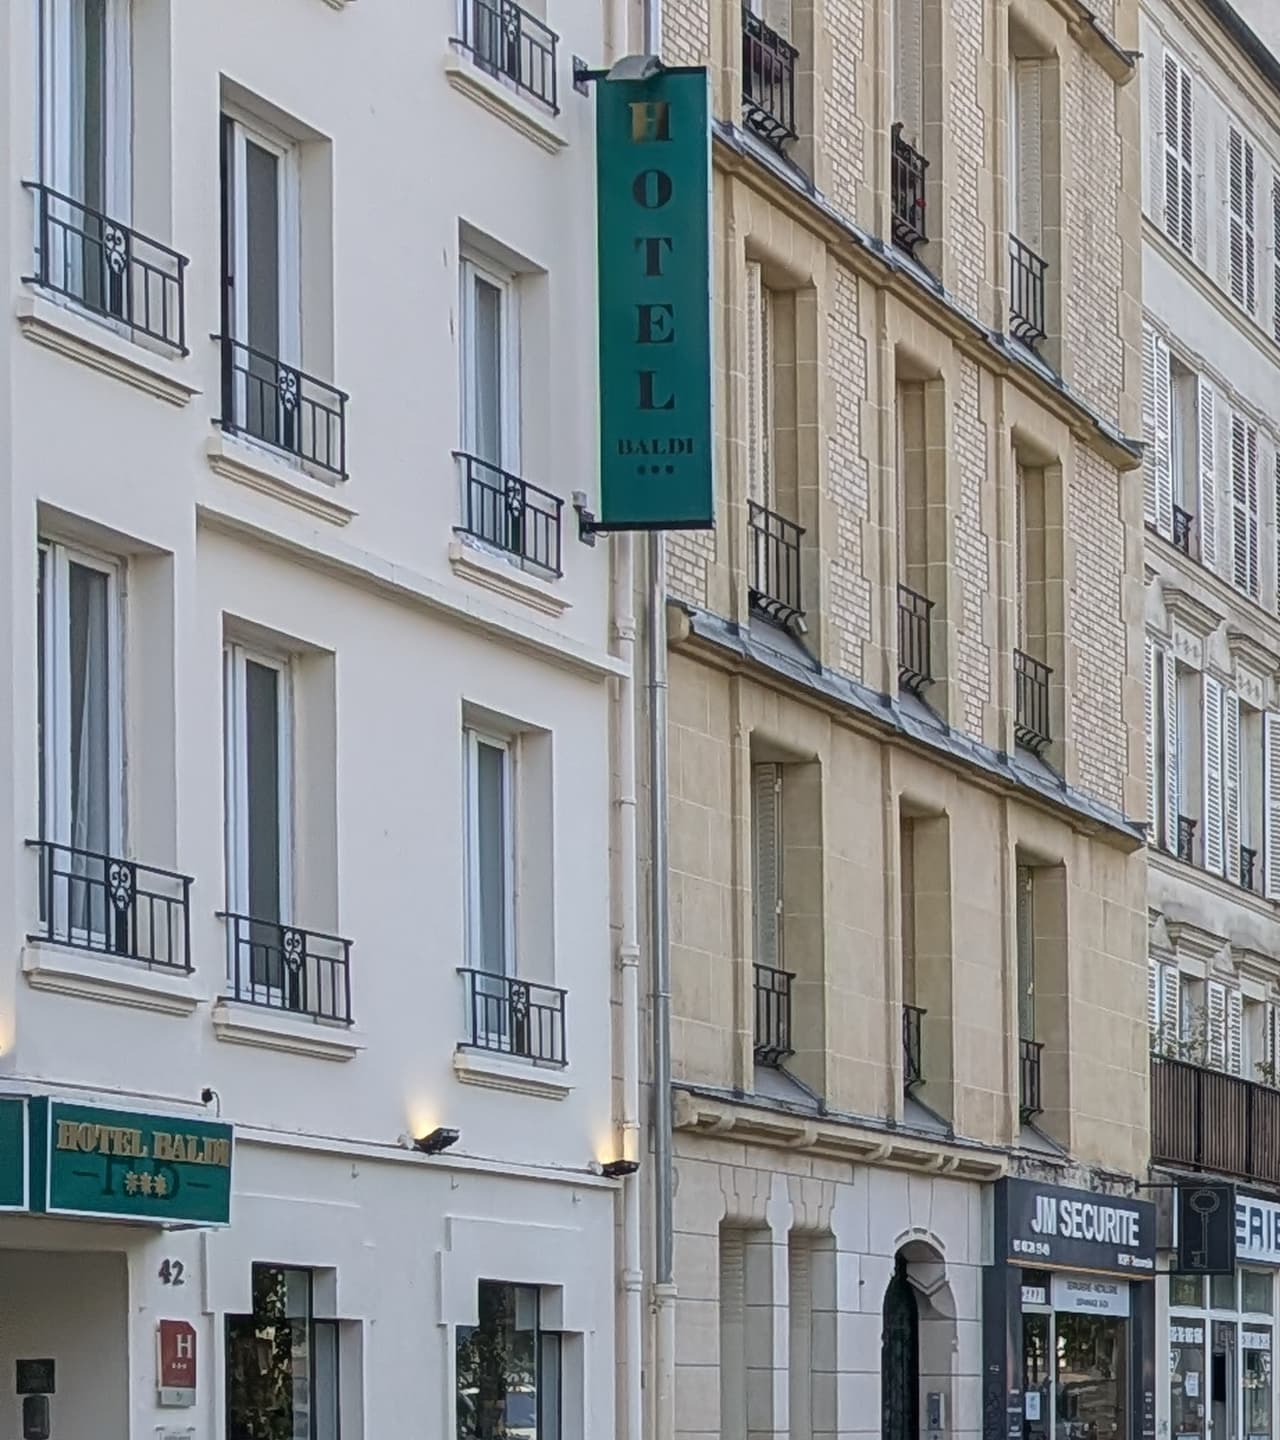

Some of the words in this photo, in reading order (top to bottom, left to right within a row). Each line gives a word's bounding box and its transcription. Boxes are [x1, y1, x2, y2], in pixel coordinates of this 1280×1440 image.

[627, 101, 675, 411] HOTEL
[617, 438, 694, 456] BALDI
[56, 1119, 149, 1157] HOTEL
[1031, 1195, 1057, 1235] JM
[1059, 1199, 1140, 1247] SECURITE
[158, 1258, 185, 1286] 42
[175, 1333, 193, 1359] H
